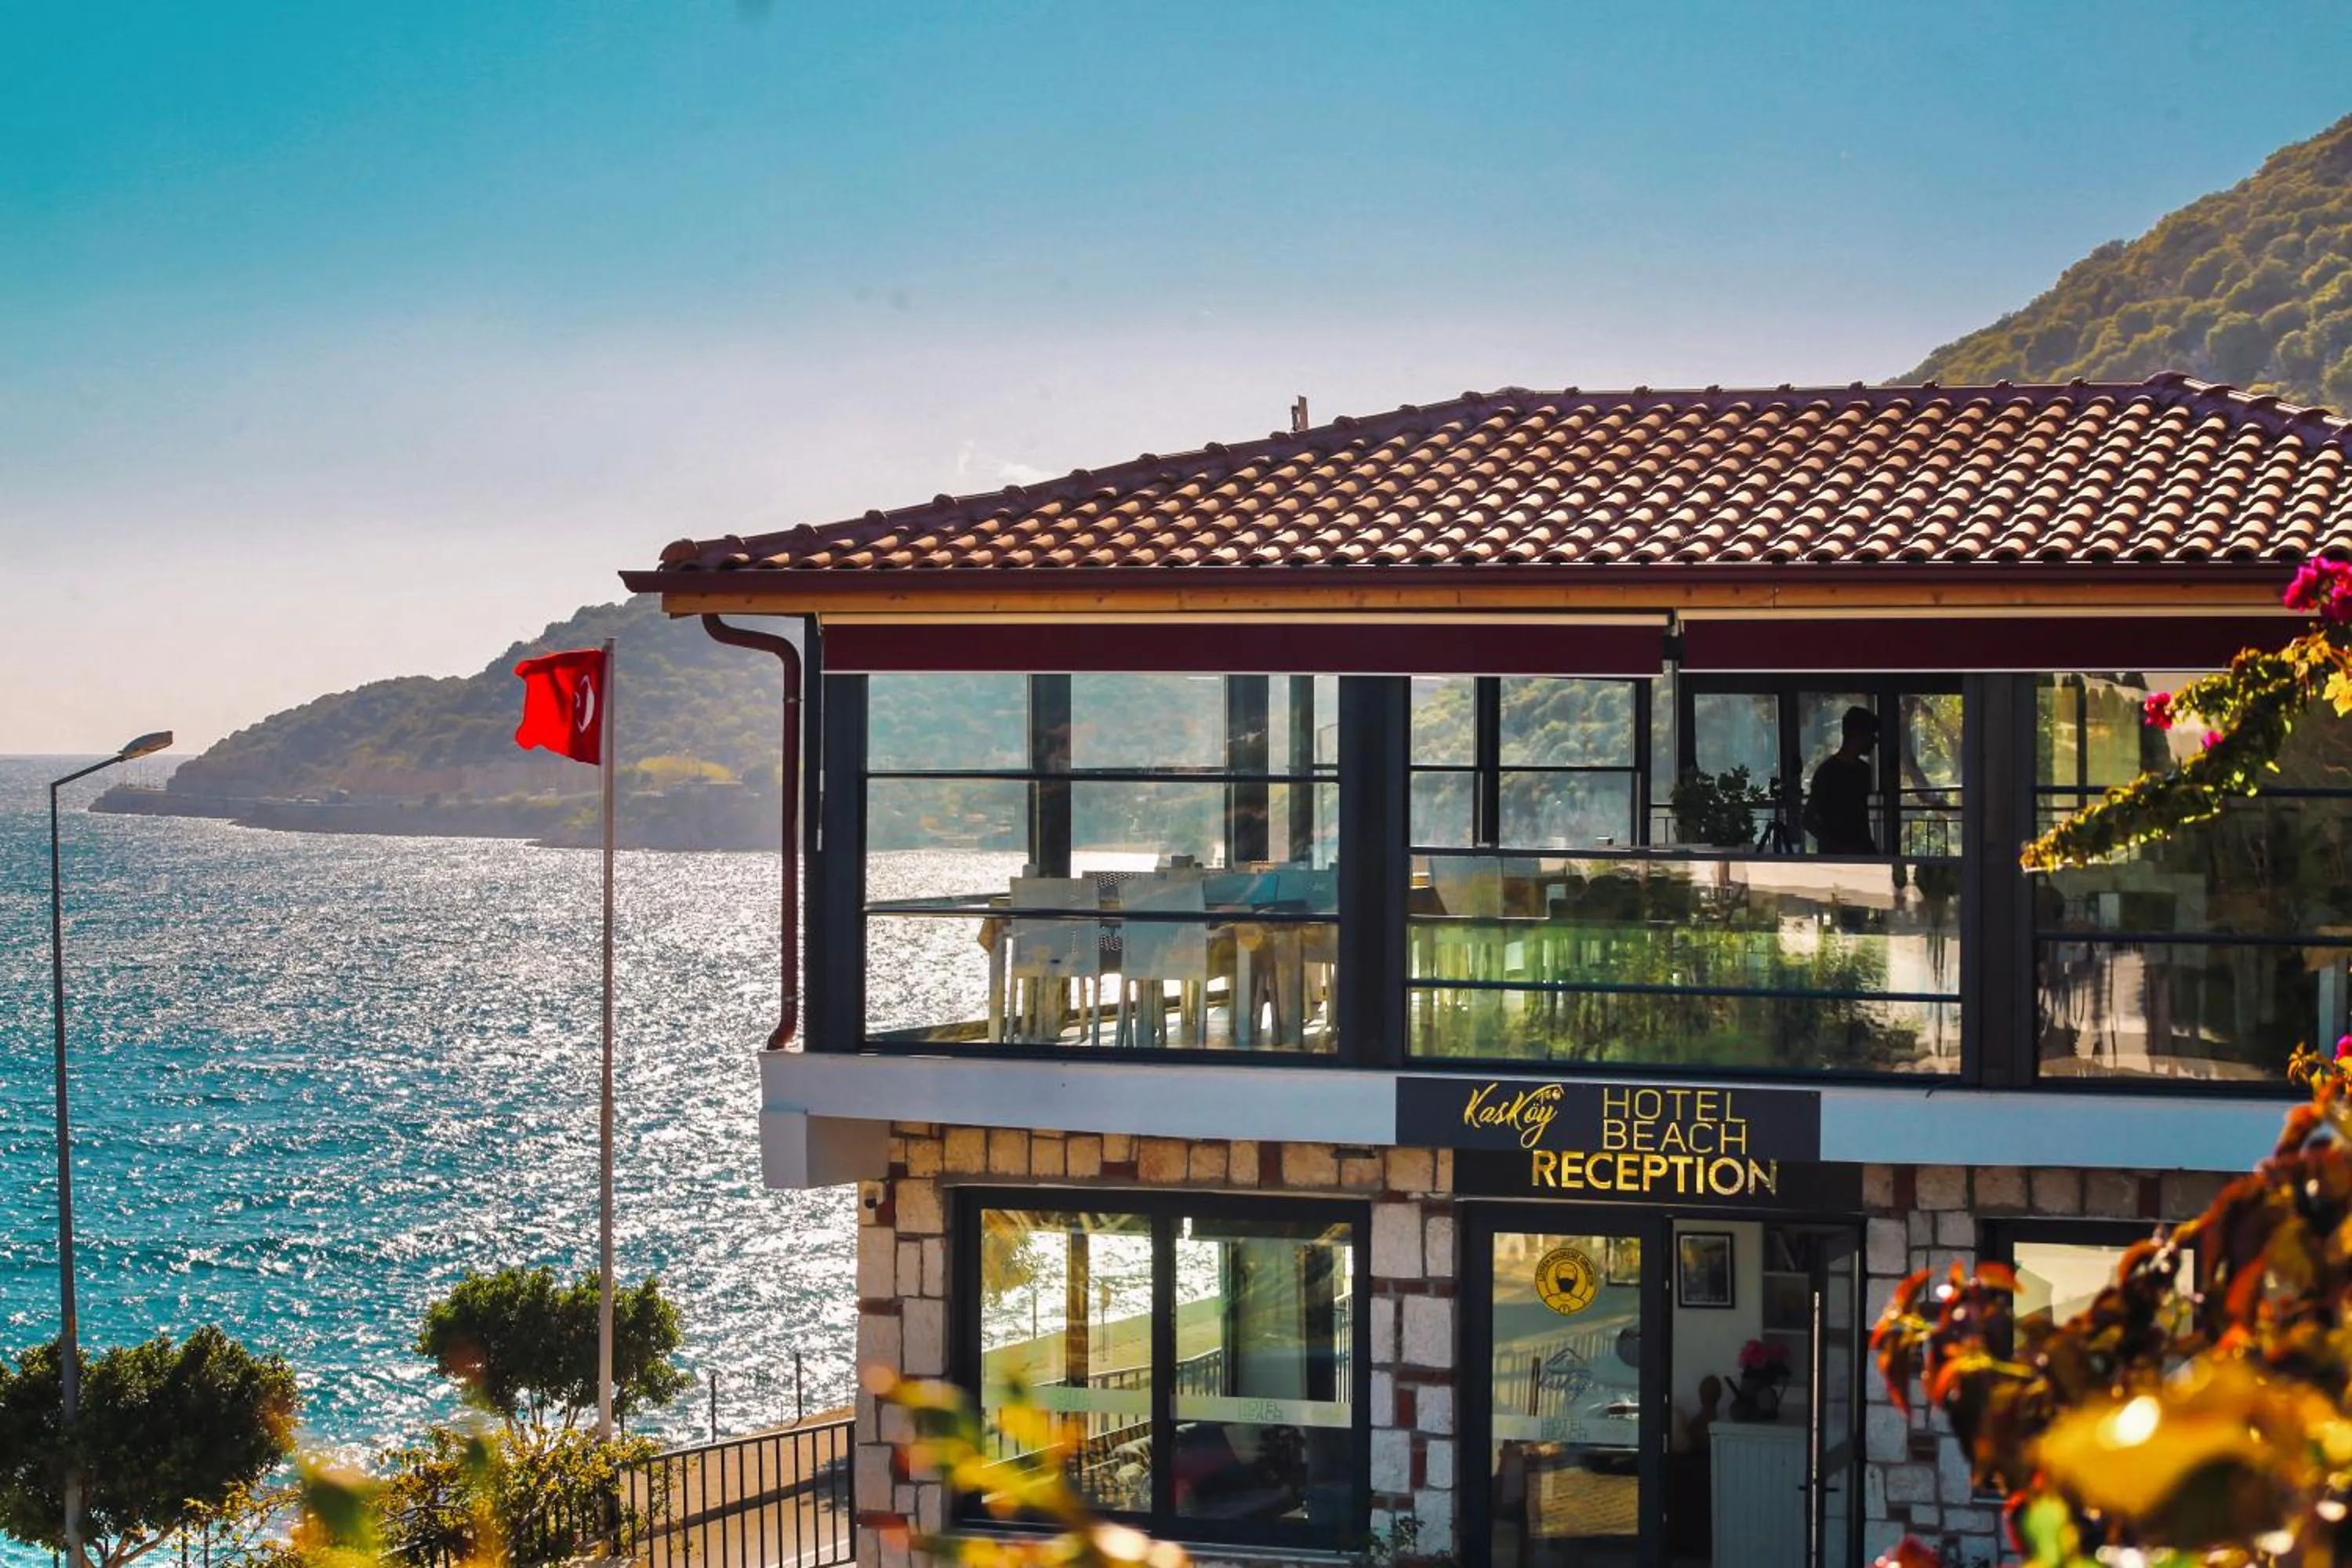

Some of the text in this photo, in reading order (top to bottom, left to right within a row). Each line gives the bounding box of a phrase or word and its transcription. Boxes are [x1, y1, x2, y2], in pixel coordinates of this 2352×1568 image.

[1603, 1087, 1746, 1123] HOTEL
[1602, 1119, 1747, 1155] BEACH
[1532, 1149, 1777, 1196] RECEPTION
